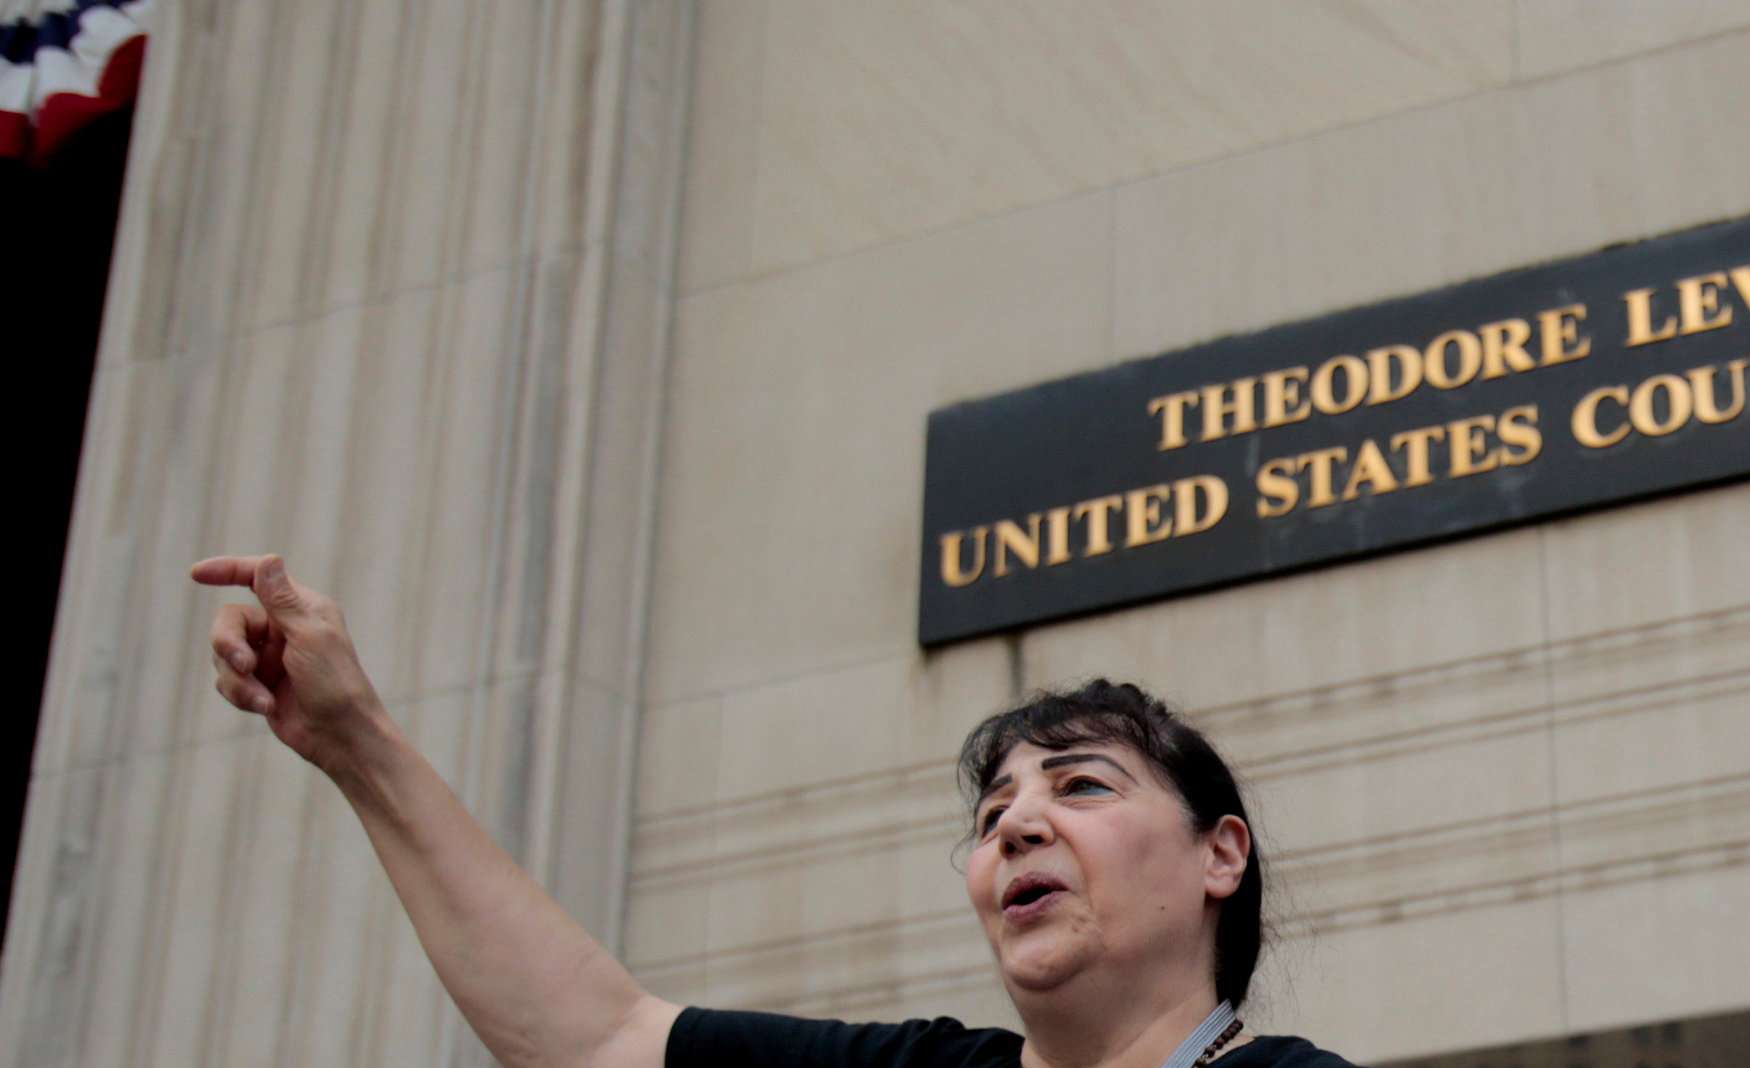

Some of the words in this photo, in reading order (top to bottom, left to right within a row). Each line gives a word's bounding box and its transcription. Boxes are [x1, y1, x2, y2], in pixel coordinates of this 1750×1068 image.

[1148, 303, 1592, 451] THEODORE
[938, 474, 1229, 588] UNITED
[1255, 404, 1542, 519] STATES
